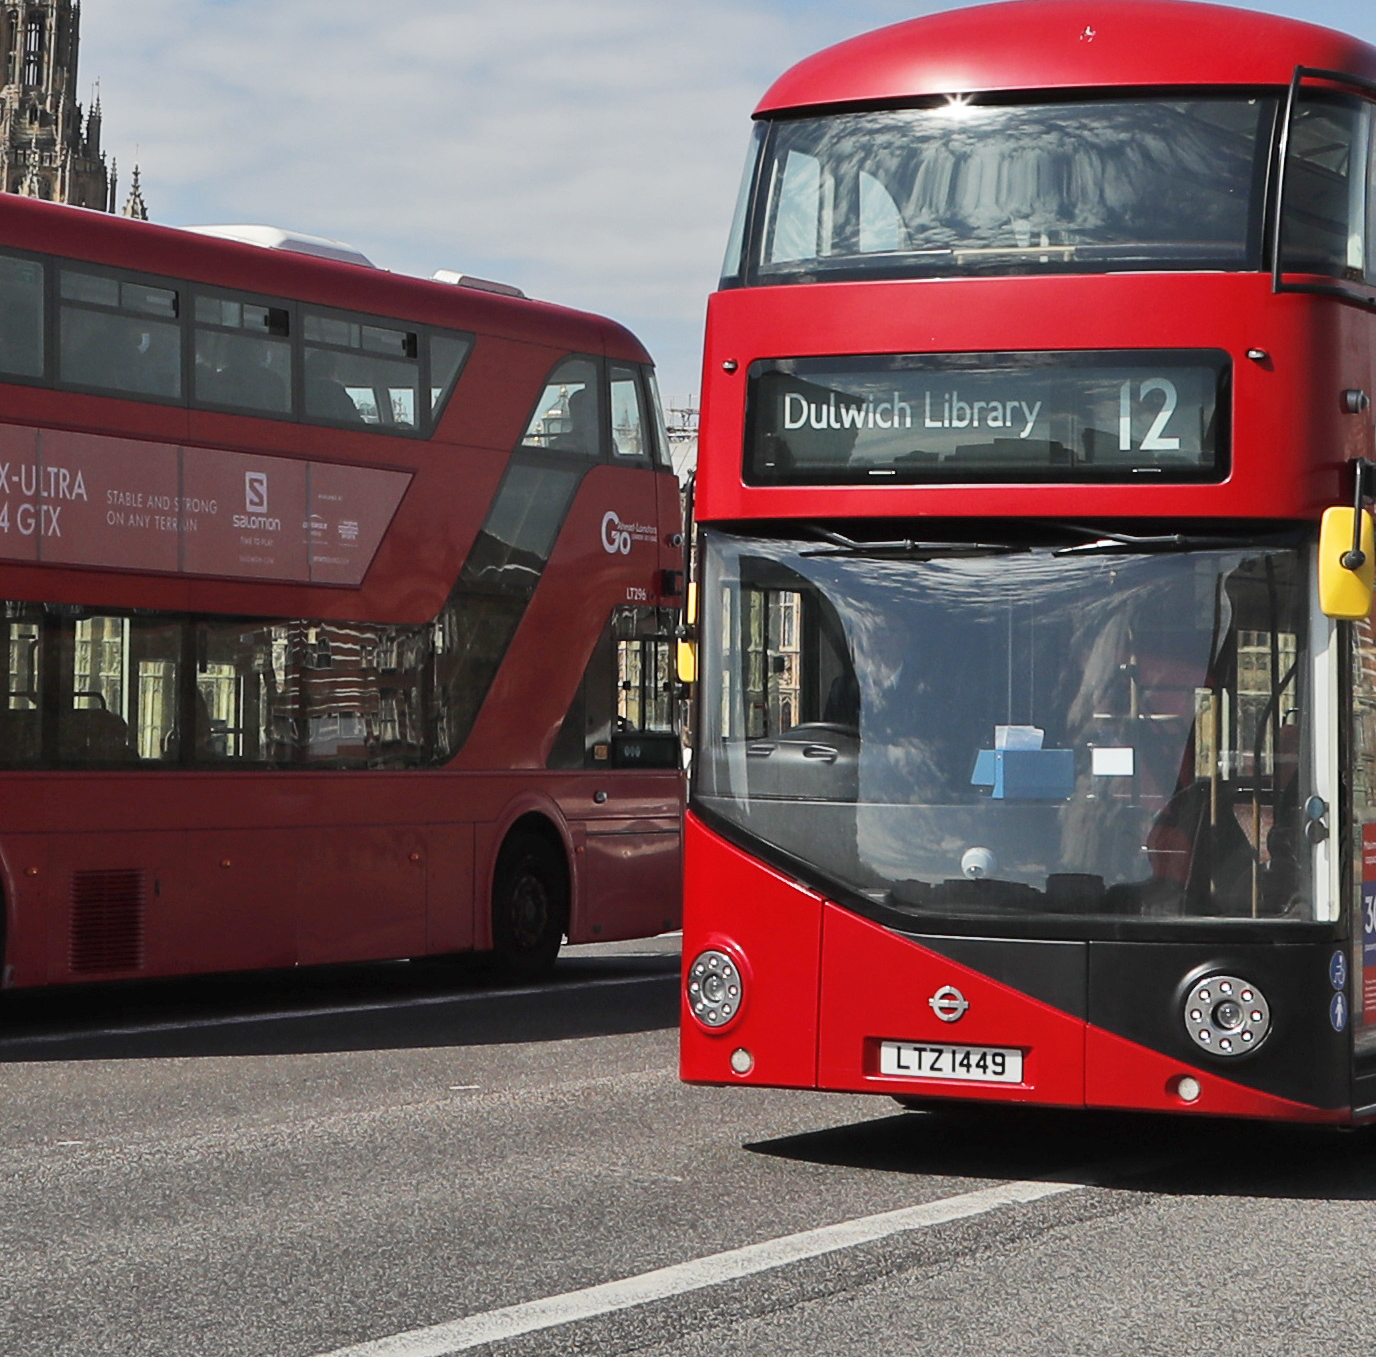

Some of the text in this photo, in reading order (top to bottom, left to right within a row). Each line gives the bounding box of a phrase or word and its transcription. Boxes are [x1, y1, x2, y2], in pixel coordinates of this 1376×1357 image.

[783, 390, 1042, 439] Dulwich Library
[1118, 377, 1180, 451] 12
[106, 490, 218, 514] STABLE AND SRONG
[17, 503, 61, 537] GTX
[106, 511, 198, 532] ON ANY TERRIN
[232, 514, 281, 531] salomon
[601, 510, 631, 555] Go
[626, 587, 647, 601] LT296
